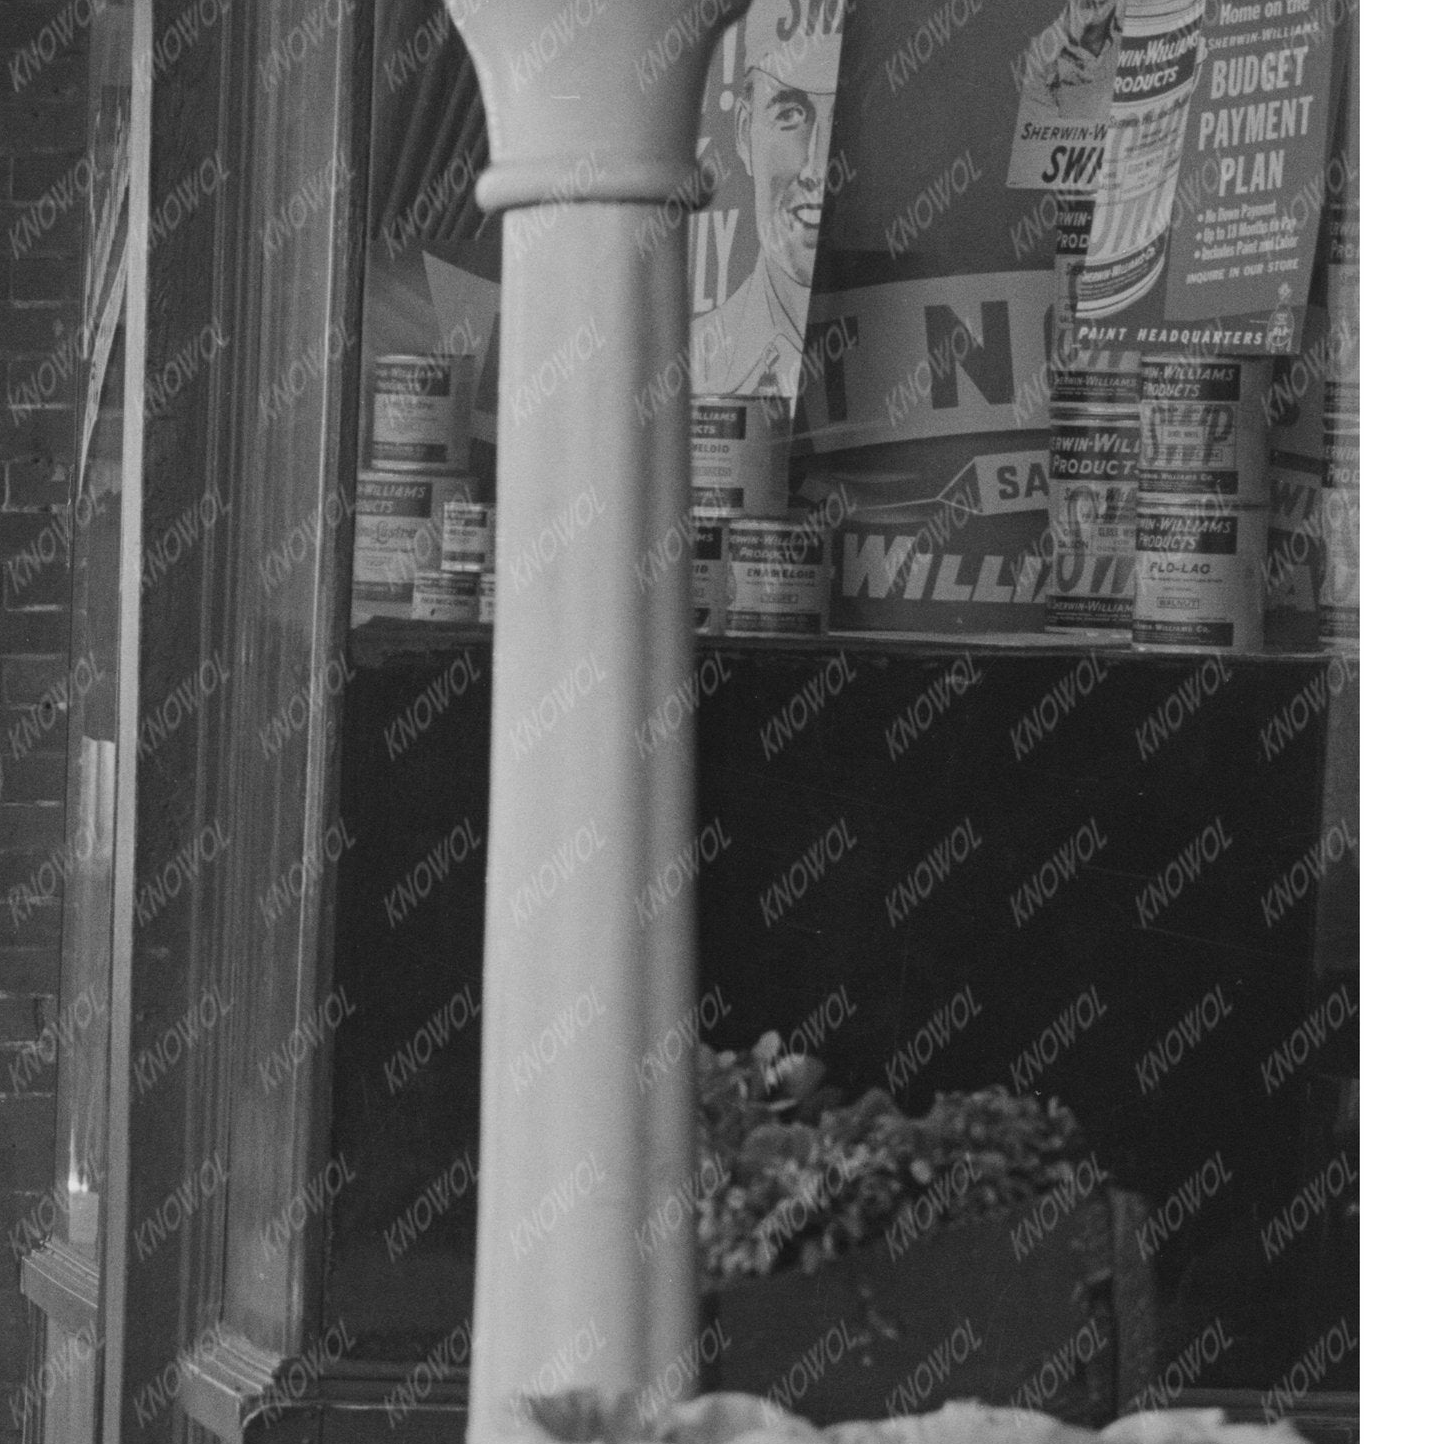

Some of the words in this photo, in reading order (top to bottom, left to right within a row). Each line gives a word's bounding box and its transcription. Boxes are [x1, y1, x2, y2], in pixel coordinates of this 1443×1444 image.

[1219, 3, 1261, 26] Home
[1264, 1, 1282, 19] on
[1210, 45, 1310, 100] BUDGET
[1197, 95, 1314, 152] PAYMENT
[1218, 149, 1286, 198] PLAN
[1186, 269, 1225, 284] INQUIRE
[1228, 266, 1240, 278] IN
[1243, 263, 1264, 276] OUR
[1267, 258, 1299, 273] STORE
[1078, 326, 1128, 342] PAINT
[1137, 328, 1264, 345] HEADQUARTERS
